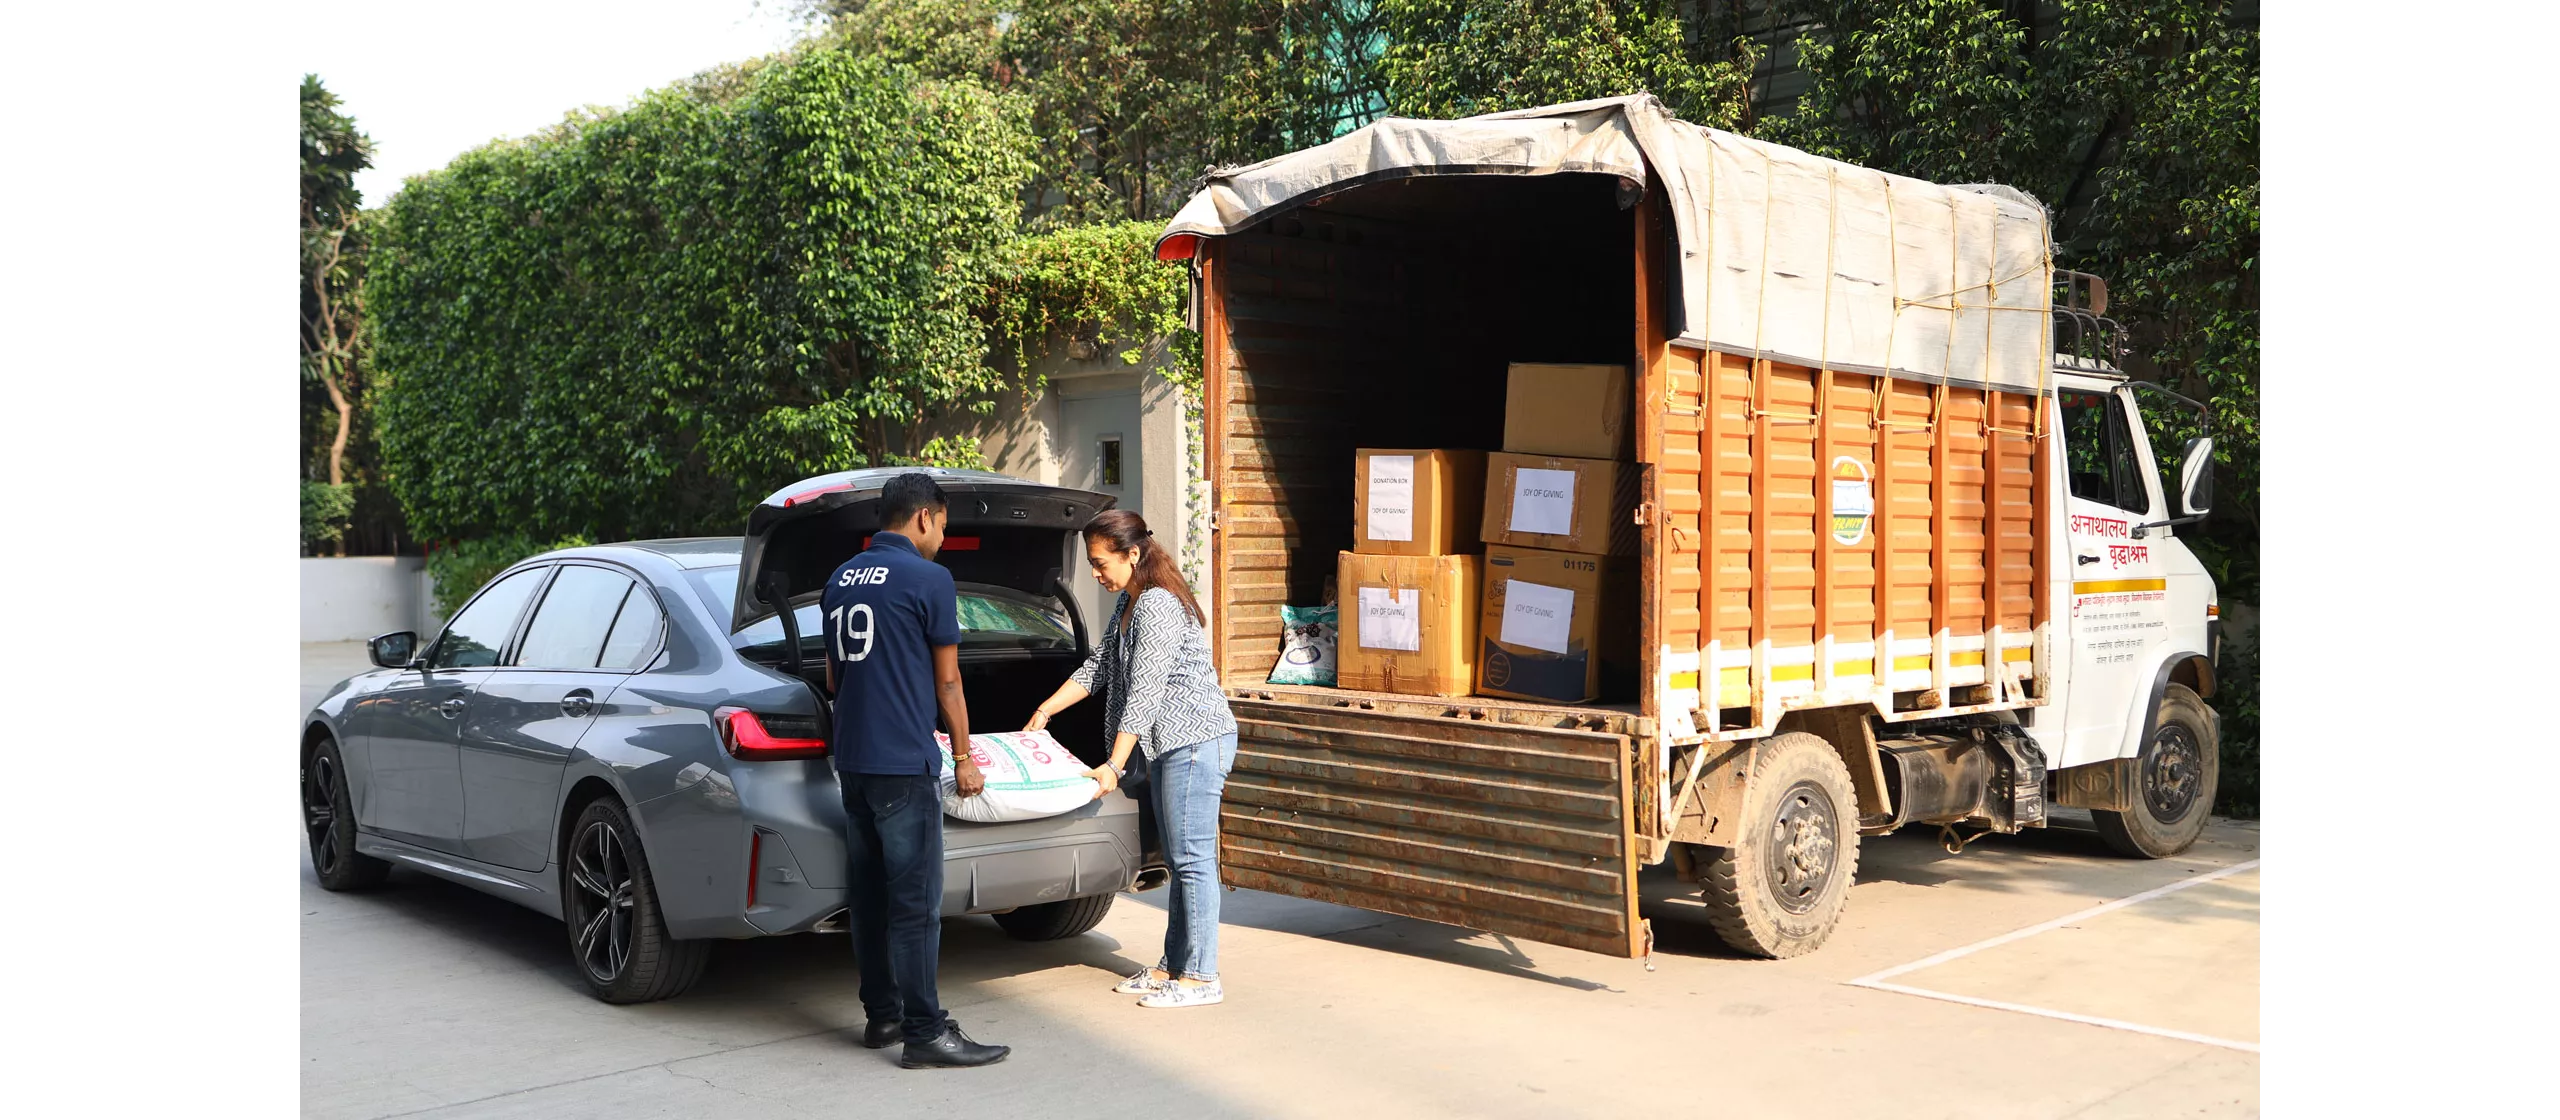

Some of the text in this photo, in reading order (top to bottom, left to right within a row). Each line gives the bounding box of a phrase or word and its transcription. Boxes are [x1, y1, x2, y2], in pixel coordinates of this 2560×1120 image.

[1523, 488, 1564, 499] JOY OF GIVING
[2070, 514, 2128, 539] अनाथालय
[1563, 559, 1596, 572] 01175
[2108, 544, 2149, 570] वृद्धाश्रम
[838, 566, 890, 587] SHIB
[1370, 607, 1405, 617] JOY OF GIVING
[1514, 603, 1554, 619] JOY OF GIVING
[829, 603, 875, 662] 19
